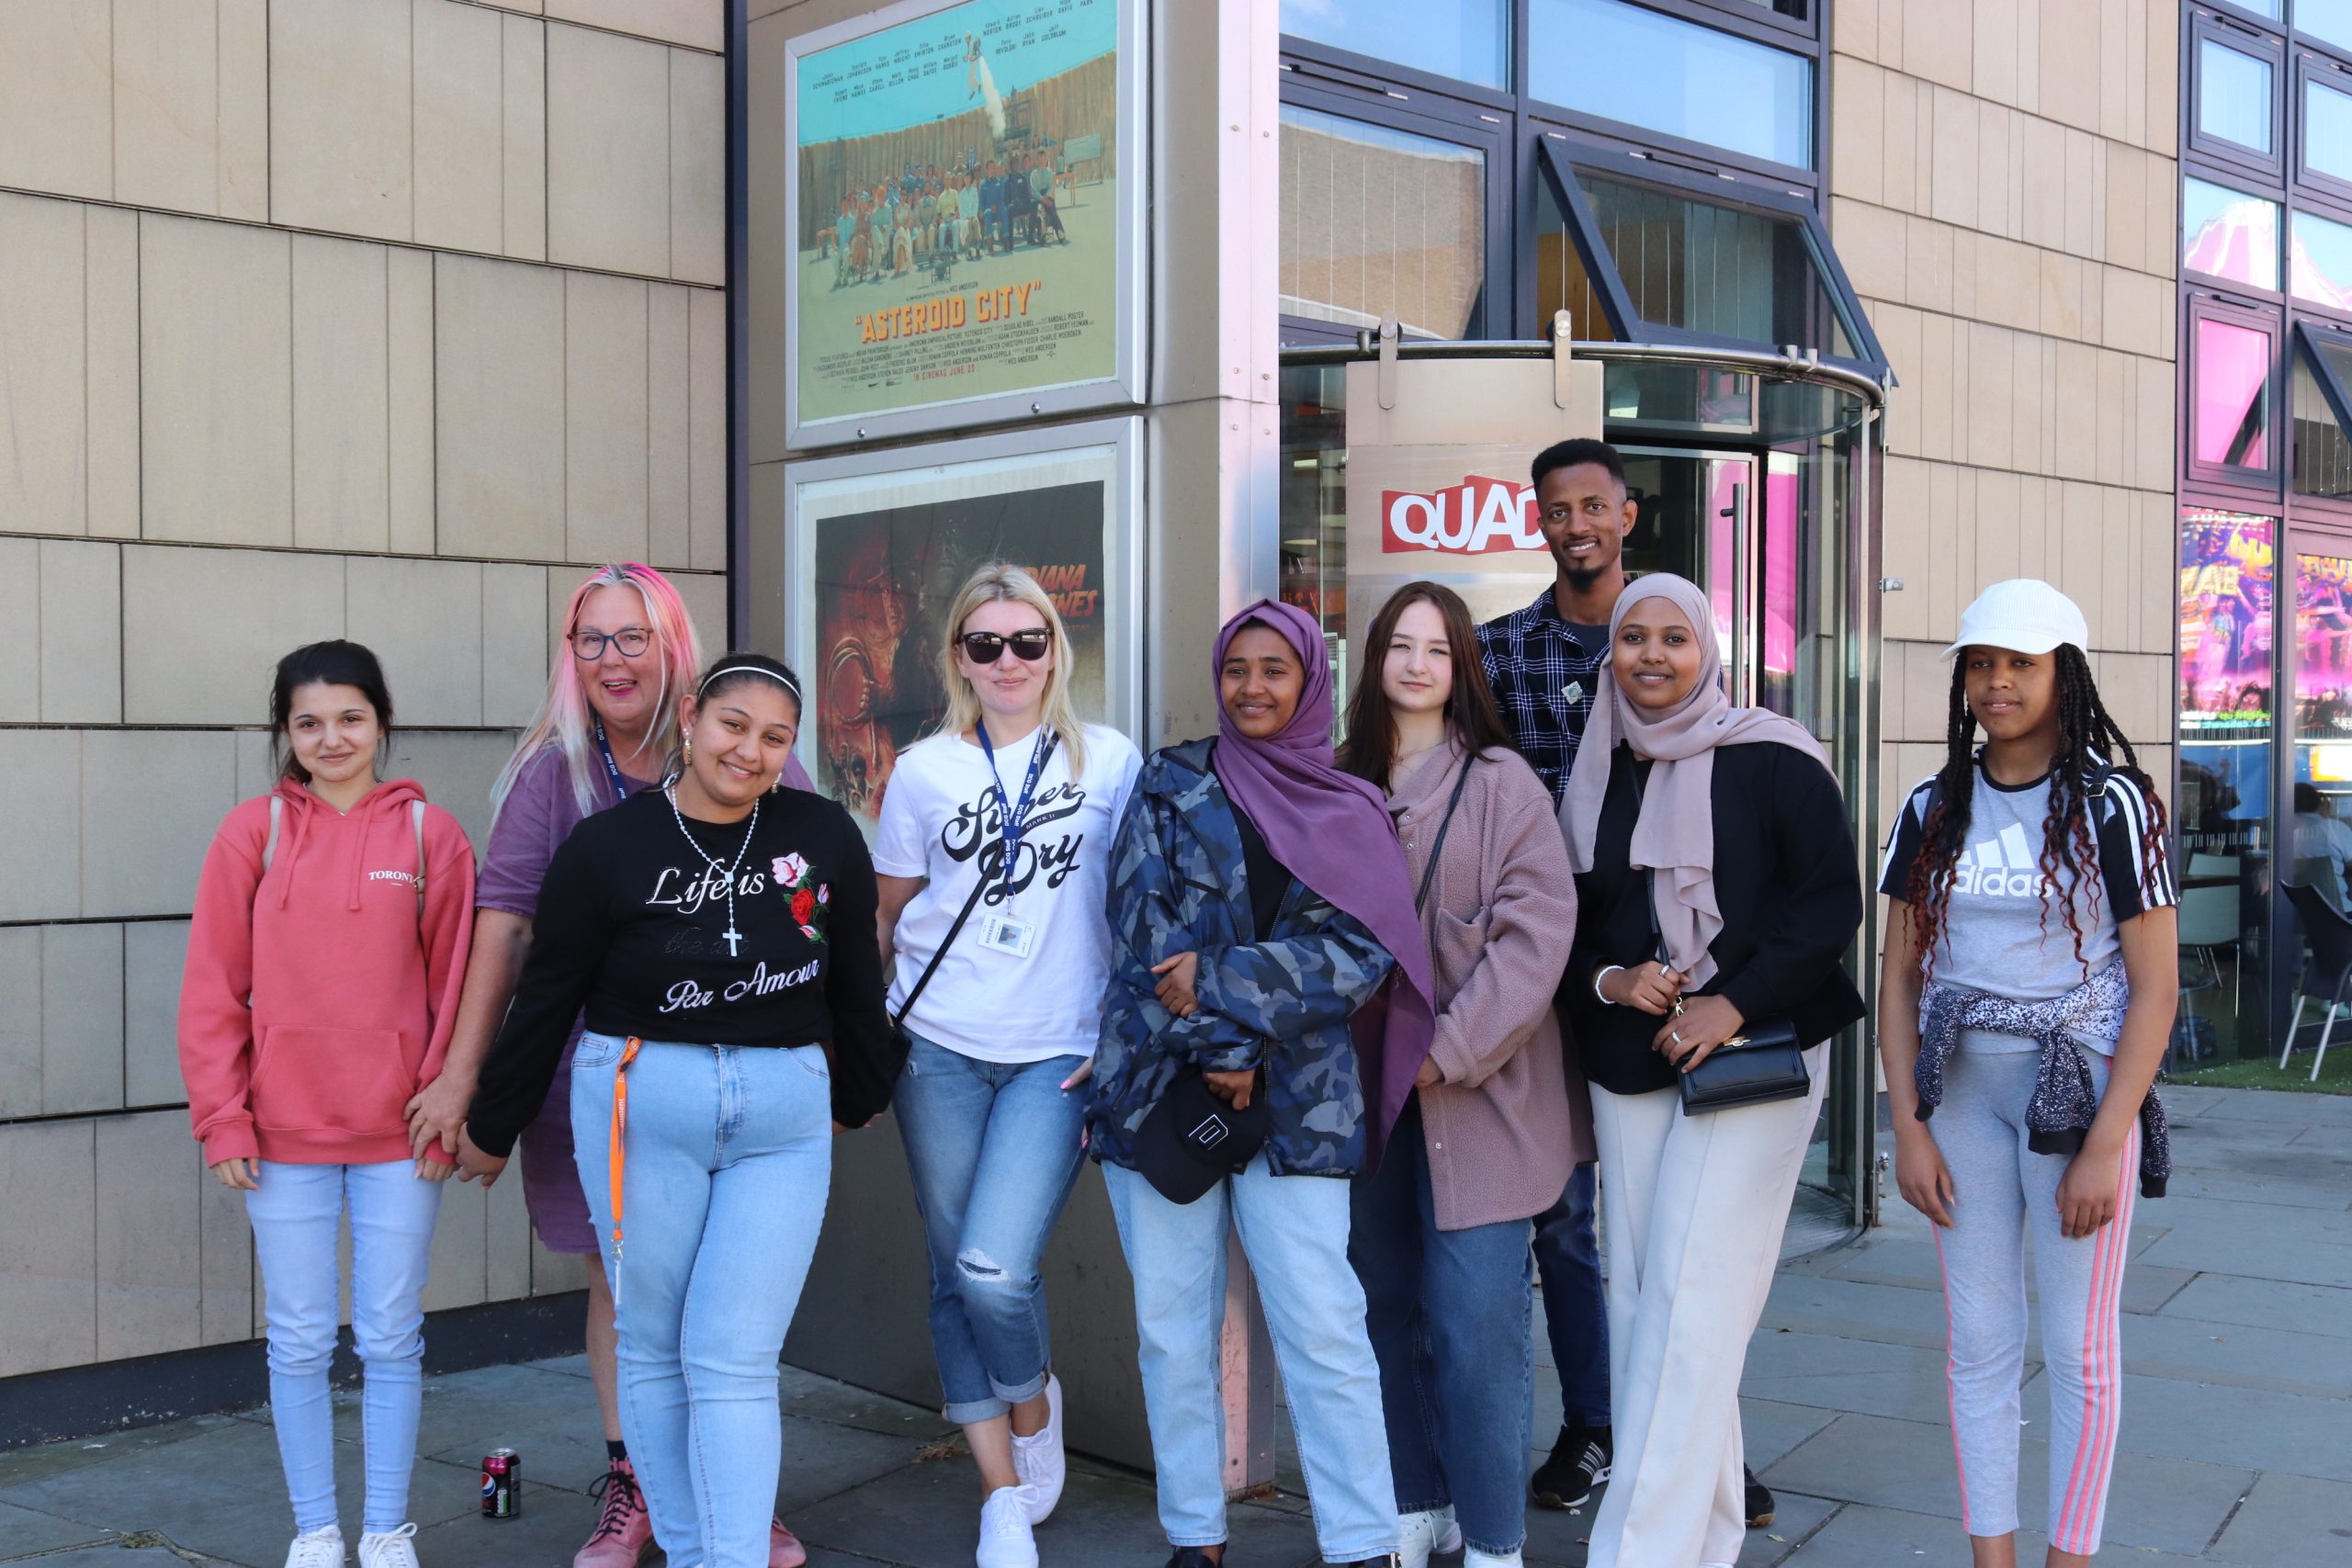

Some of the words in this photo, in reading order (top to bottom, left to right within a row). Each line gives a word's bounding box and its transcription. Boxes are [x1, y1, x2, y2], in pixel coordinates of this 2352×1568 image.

[1390, 483, 1548, 552] QUAD
[646, 859, 730, 914] Life
[738, 865, 765, 897] is
[659, 979, 715, 1013] Par
[724, 959, 820, 1001] Amour
